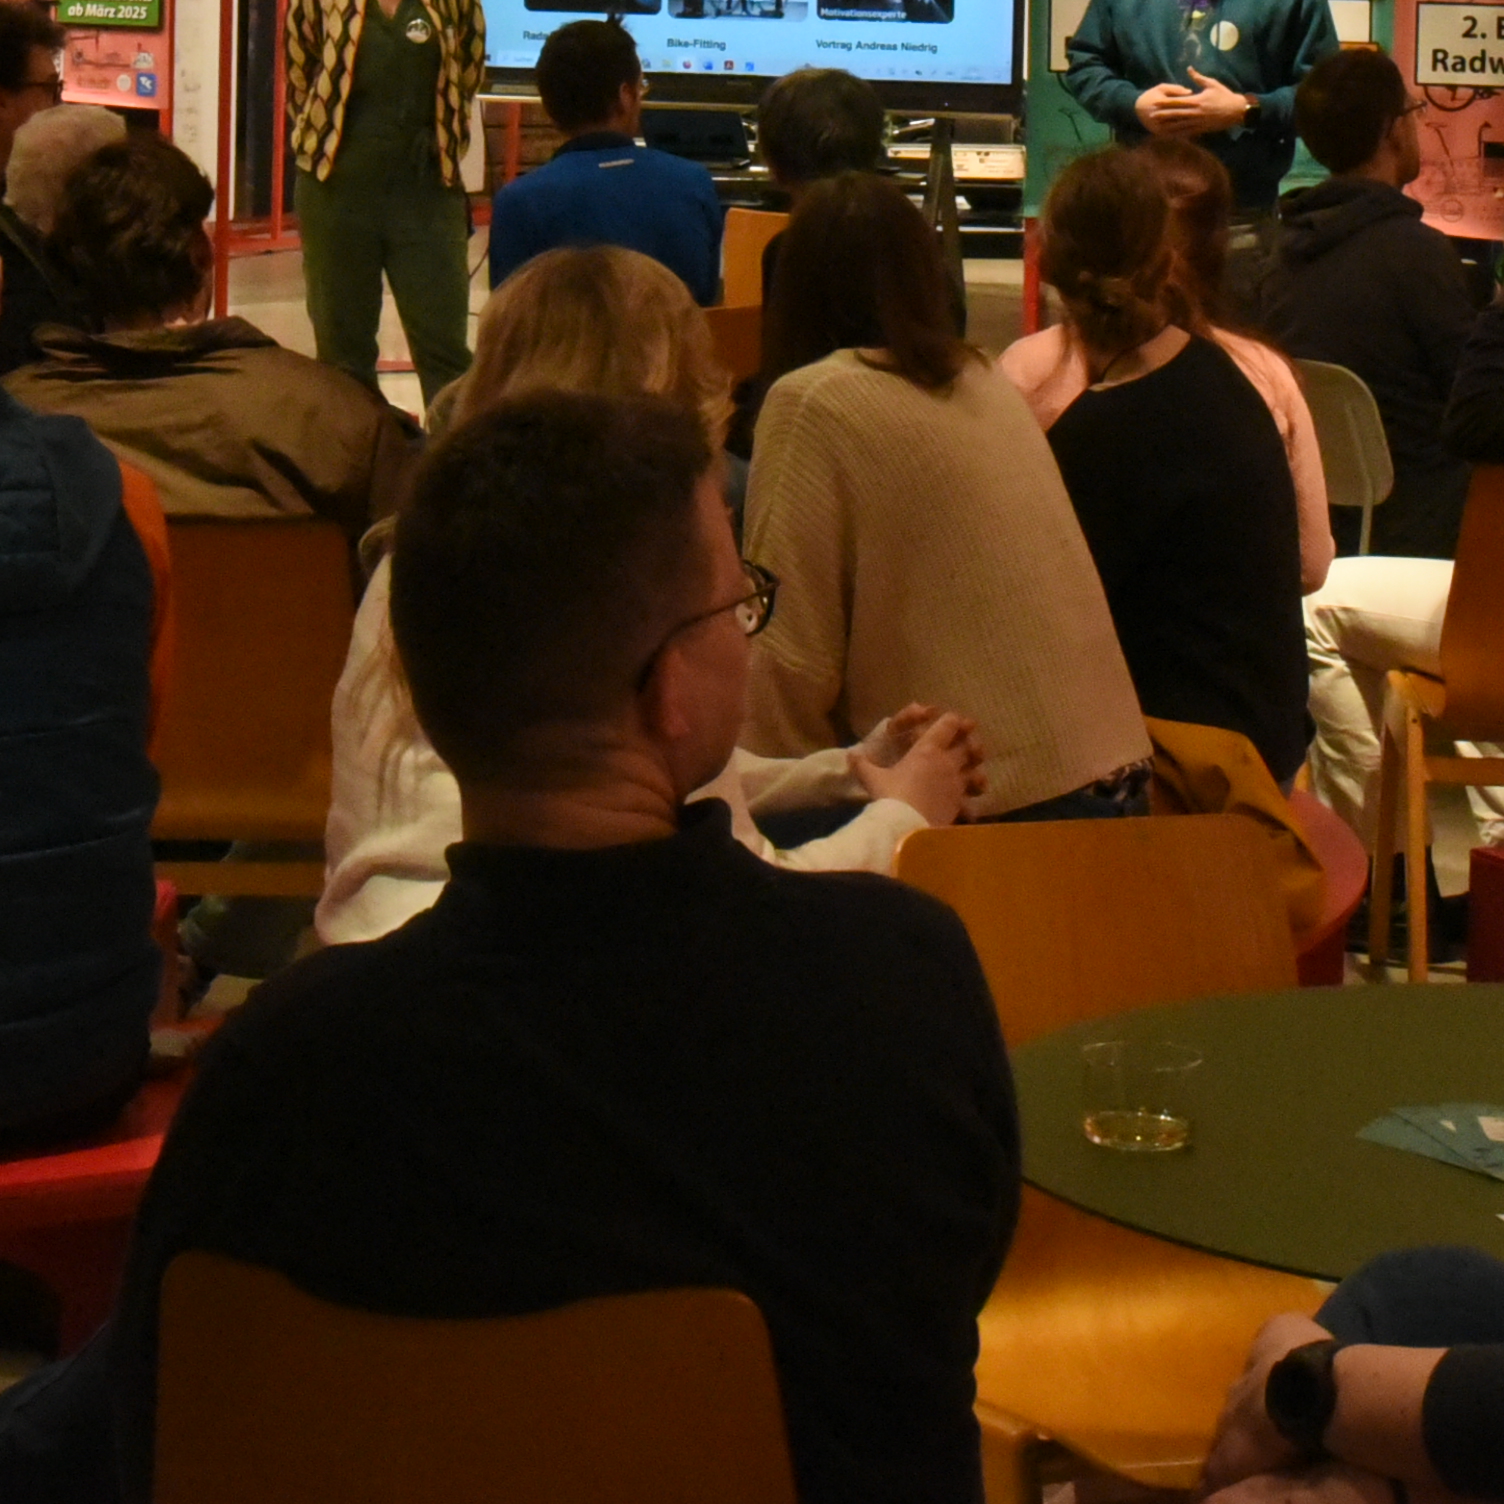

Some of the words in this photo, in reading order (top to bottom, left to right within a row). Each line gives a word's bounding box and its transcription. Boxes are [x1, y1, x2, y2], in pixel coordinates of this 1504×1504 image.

[68, 4, 83, 16] ab
[85, 3, 115, 18] März
[117, 4, 147, 19] 2025
[1461, 16, 1487, 40] 2.
[667, 38, 727, 52] Bike-Fitting
[816, 39, 852, 51] Vortrag
[855, 40, 898, 52] Andreas
[901, 42, 938, 54] Niedrig
